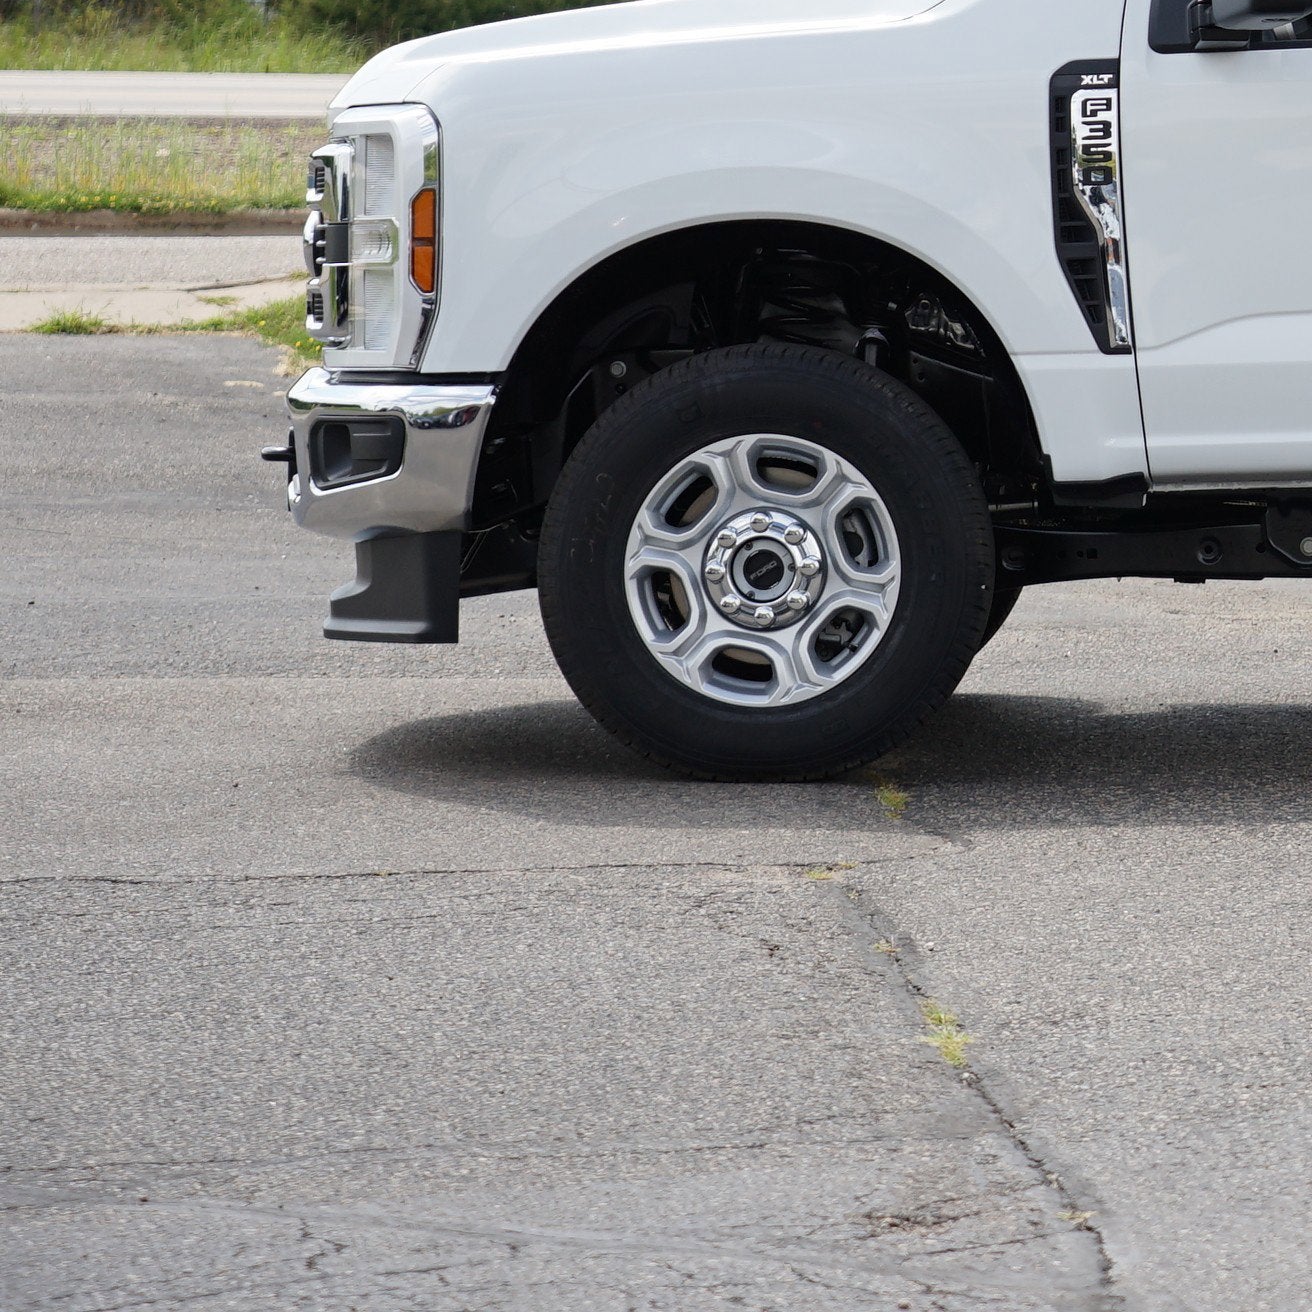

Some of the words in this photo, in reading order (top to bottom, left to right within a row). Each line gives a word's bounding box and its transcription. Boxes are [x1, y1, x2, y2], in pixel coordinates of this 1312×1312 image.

[1081, 74, 1113, 85] XLT
[1081, 97, 1113, 185] F350
[750, 561, 777, 579] FORD
